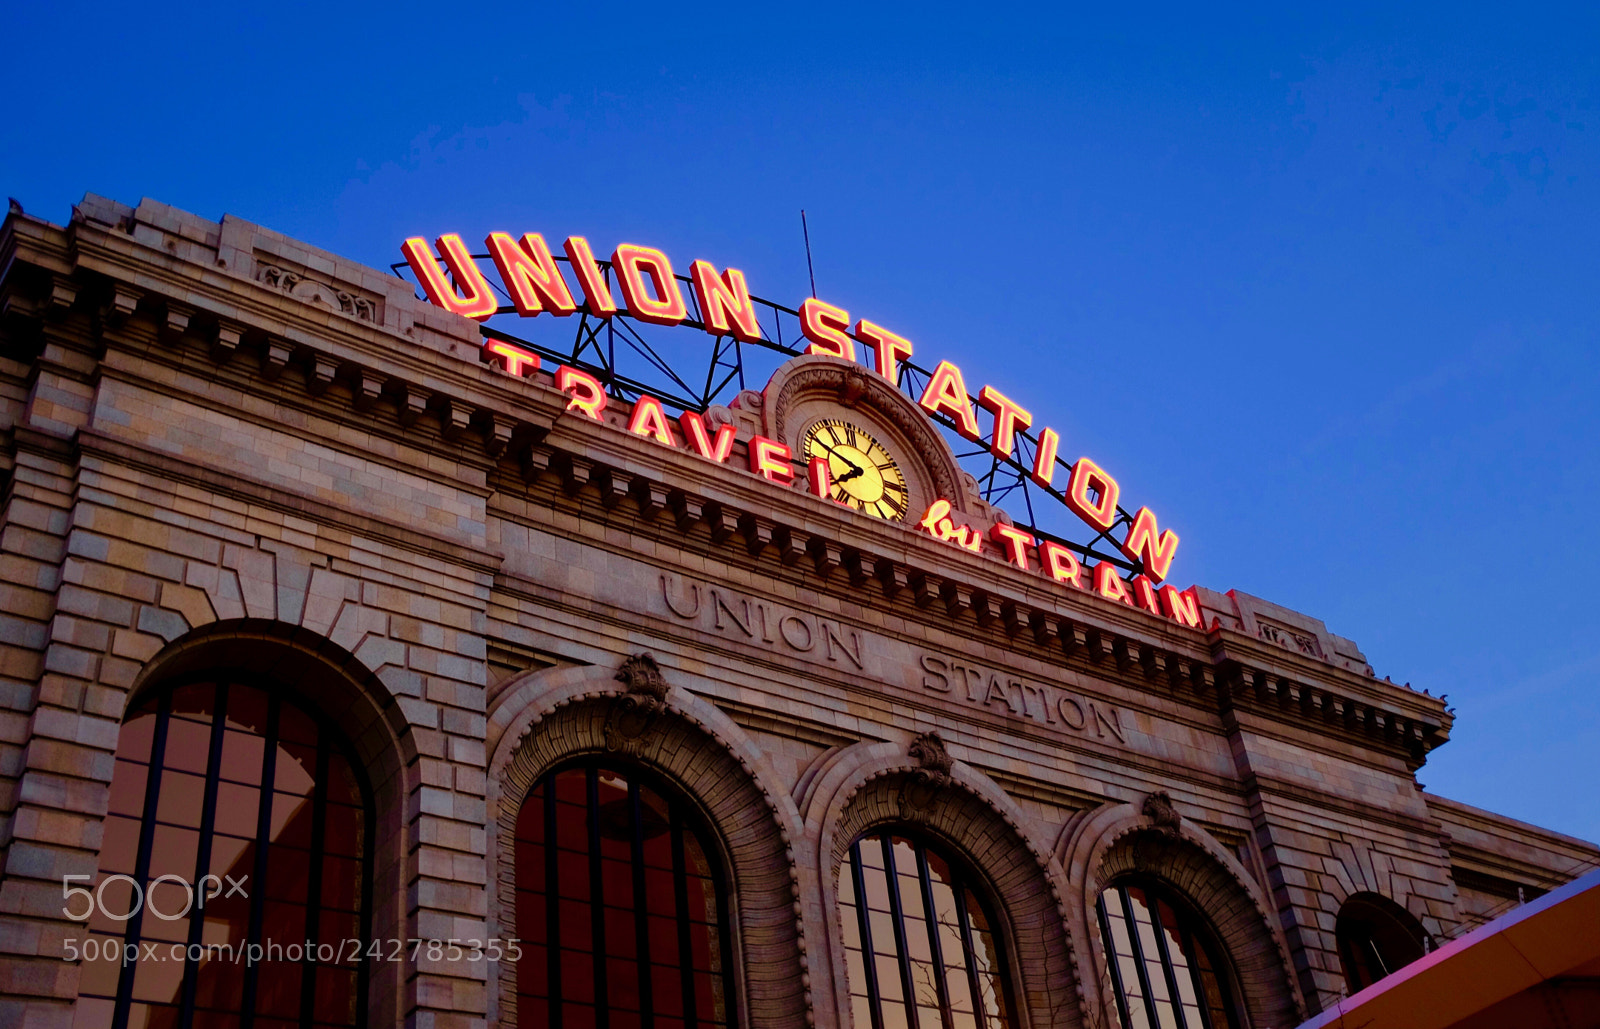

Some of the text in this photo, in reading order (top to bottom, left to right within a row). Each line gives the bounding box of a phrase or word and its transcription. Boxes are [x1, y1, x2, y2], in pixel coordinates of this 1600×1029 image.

[401, 232, 1180, 585] UNION STATION
[660, 575, 1127, 745] UNION STATION
[989, 521, 1203, 630] TRAIN
